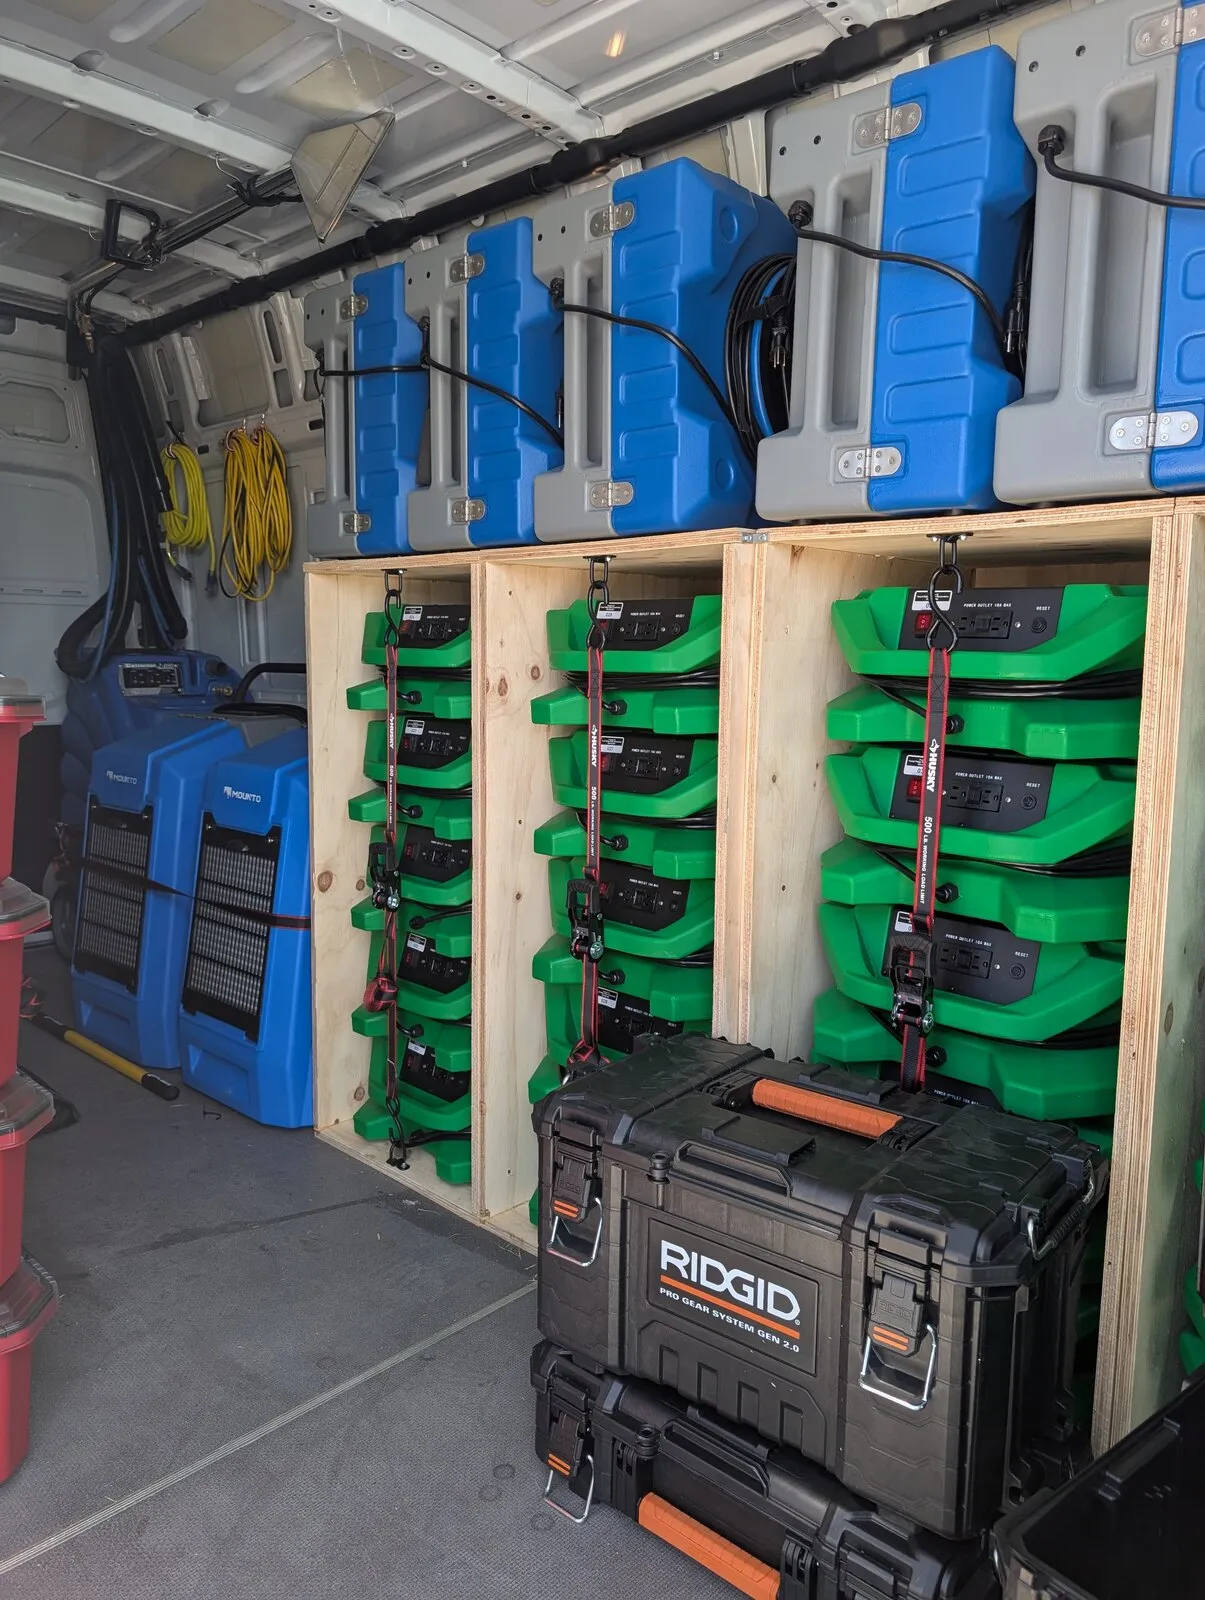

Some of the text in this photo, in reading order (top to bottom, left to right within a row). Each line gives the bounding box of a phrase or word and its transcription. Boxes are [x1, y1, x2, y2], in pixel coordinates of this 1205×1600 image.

[927, 753, 938, 792] HUSKY
[231, 790, 261, 803] MOUNTO
[924, 816, 933, 833] 500
[661, 1240, 800, 1321] RIDGID
[660, 1287, 799, 1352] PRO GEAR SYSTEM GEN 2.0
